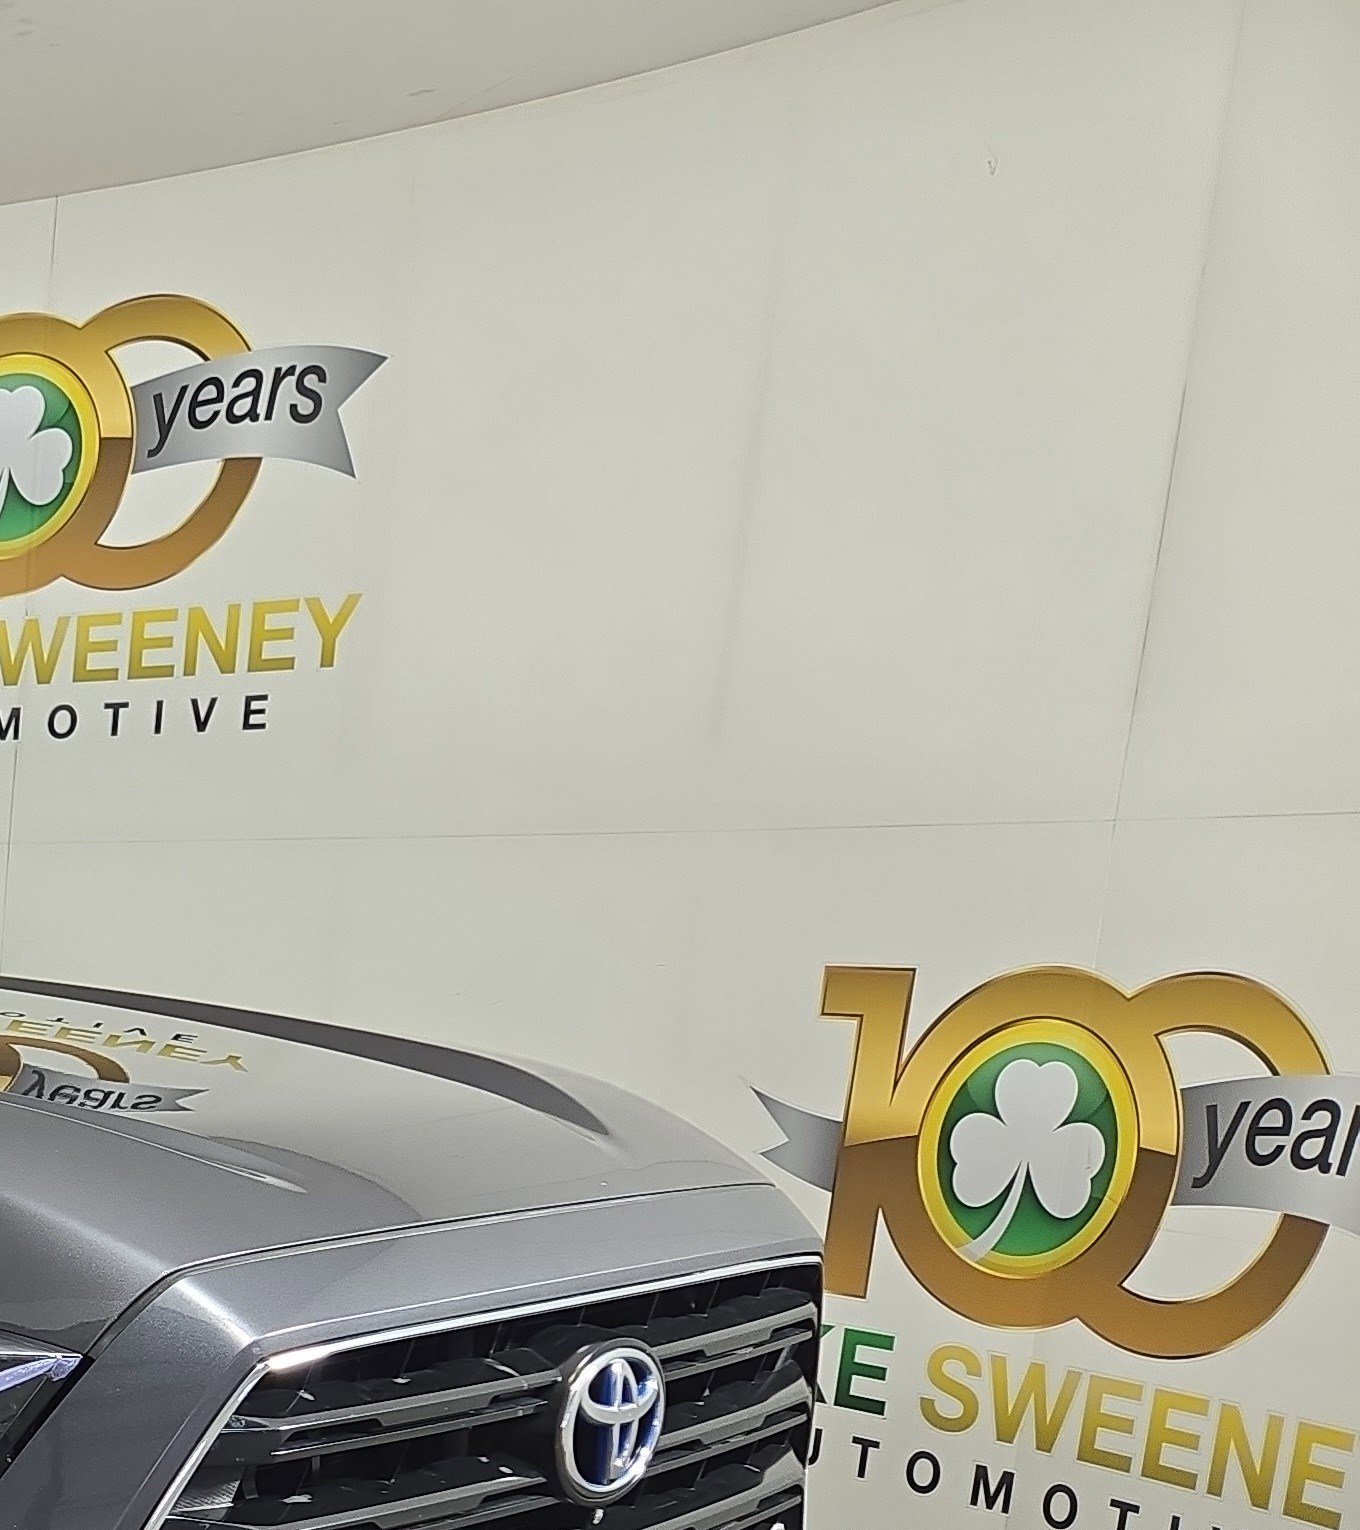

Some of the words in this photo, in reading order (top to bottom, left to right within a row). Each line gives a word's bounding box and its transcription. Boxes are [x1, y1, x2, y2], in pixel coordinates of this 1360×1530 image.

[147, 362, 328, 458] years
[821, 964, 1331, 1360] 100
[1191, 1097, 1360, 1188] year
